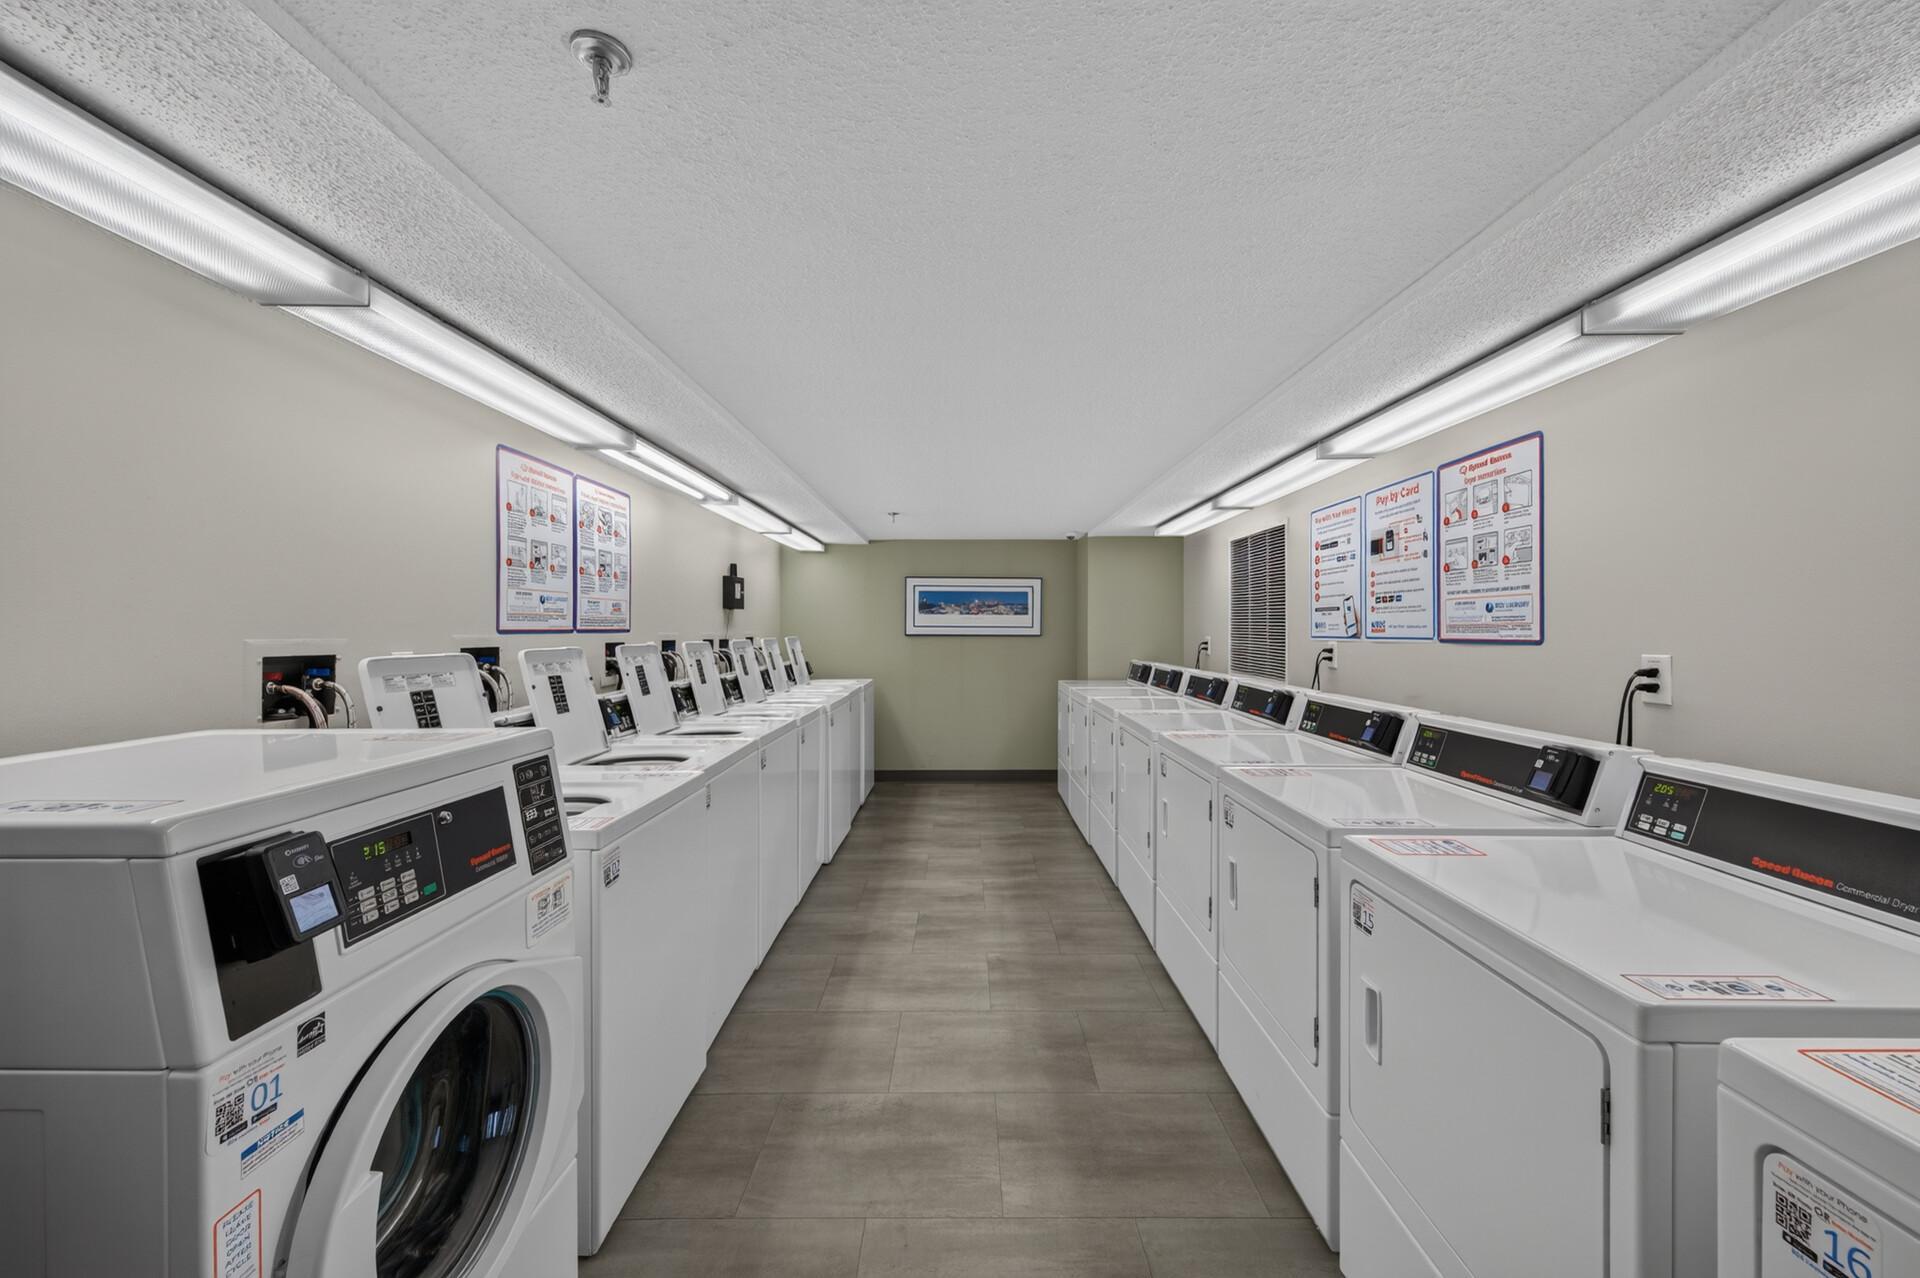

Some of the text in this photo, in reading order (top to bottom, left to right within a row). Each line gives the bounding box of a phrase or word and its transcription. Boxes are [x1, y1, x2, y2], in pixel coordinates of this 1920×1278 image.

[1375, 482, 1420, 506] Pay by Card
[1752, 856, 1791, 875] Speed
[1791, 867, 1834, 889] Queen
[1836, 881, 1890, 905] Commercial
[1363, 910, 1375, 929] 15
[251, 1073, 284, 1112] 01
[1795, 1174, 1814, 1188] with
[1836, 1199, 1868, 1223] Phone
[223, 1200, 254, 1229] PLEASE
[225, 1213, 251, 1237] LEAVE
[1814, 1206, 1831, 1224] OR
[225, 1222, 251, 1248] DOOR
[226, 1233, 251, 1257] OPEN
[225, 1241, 252, 1269] AFTER
[1823, 1229, 1873, 1278] 16
